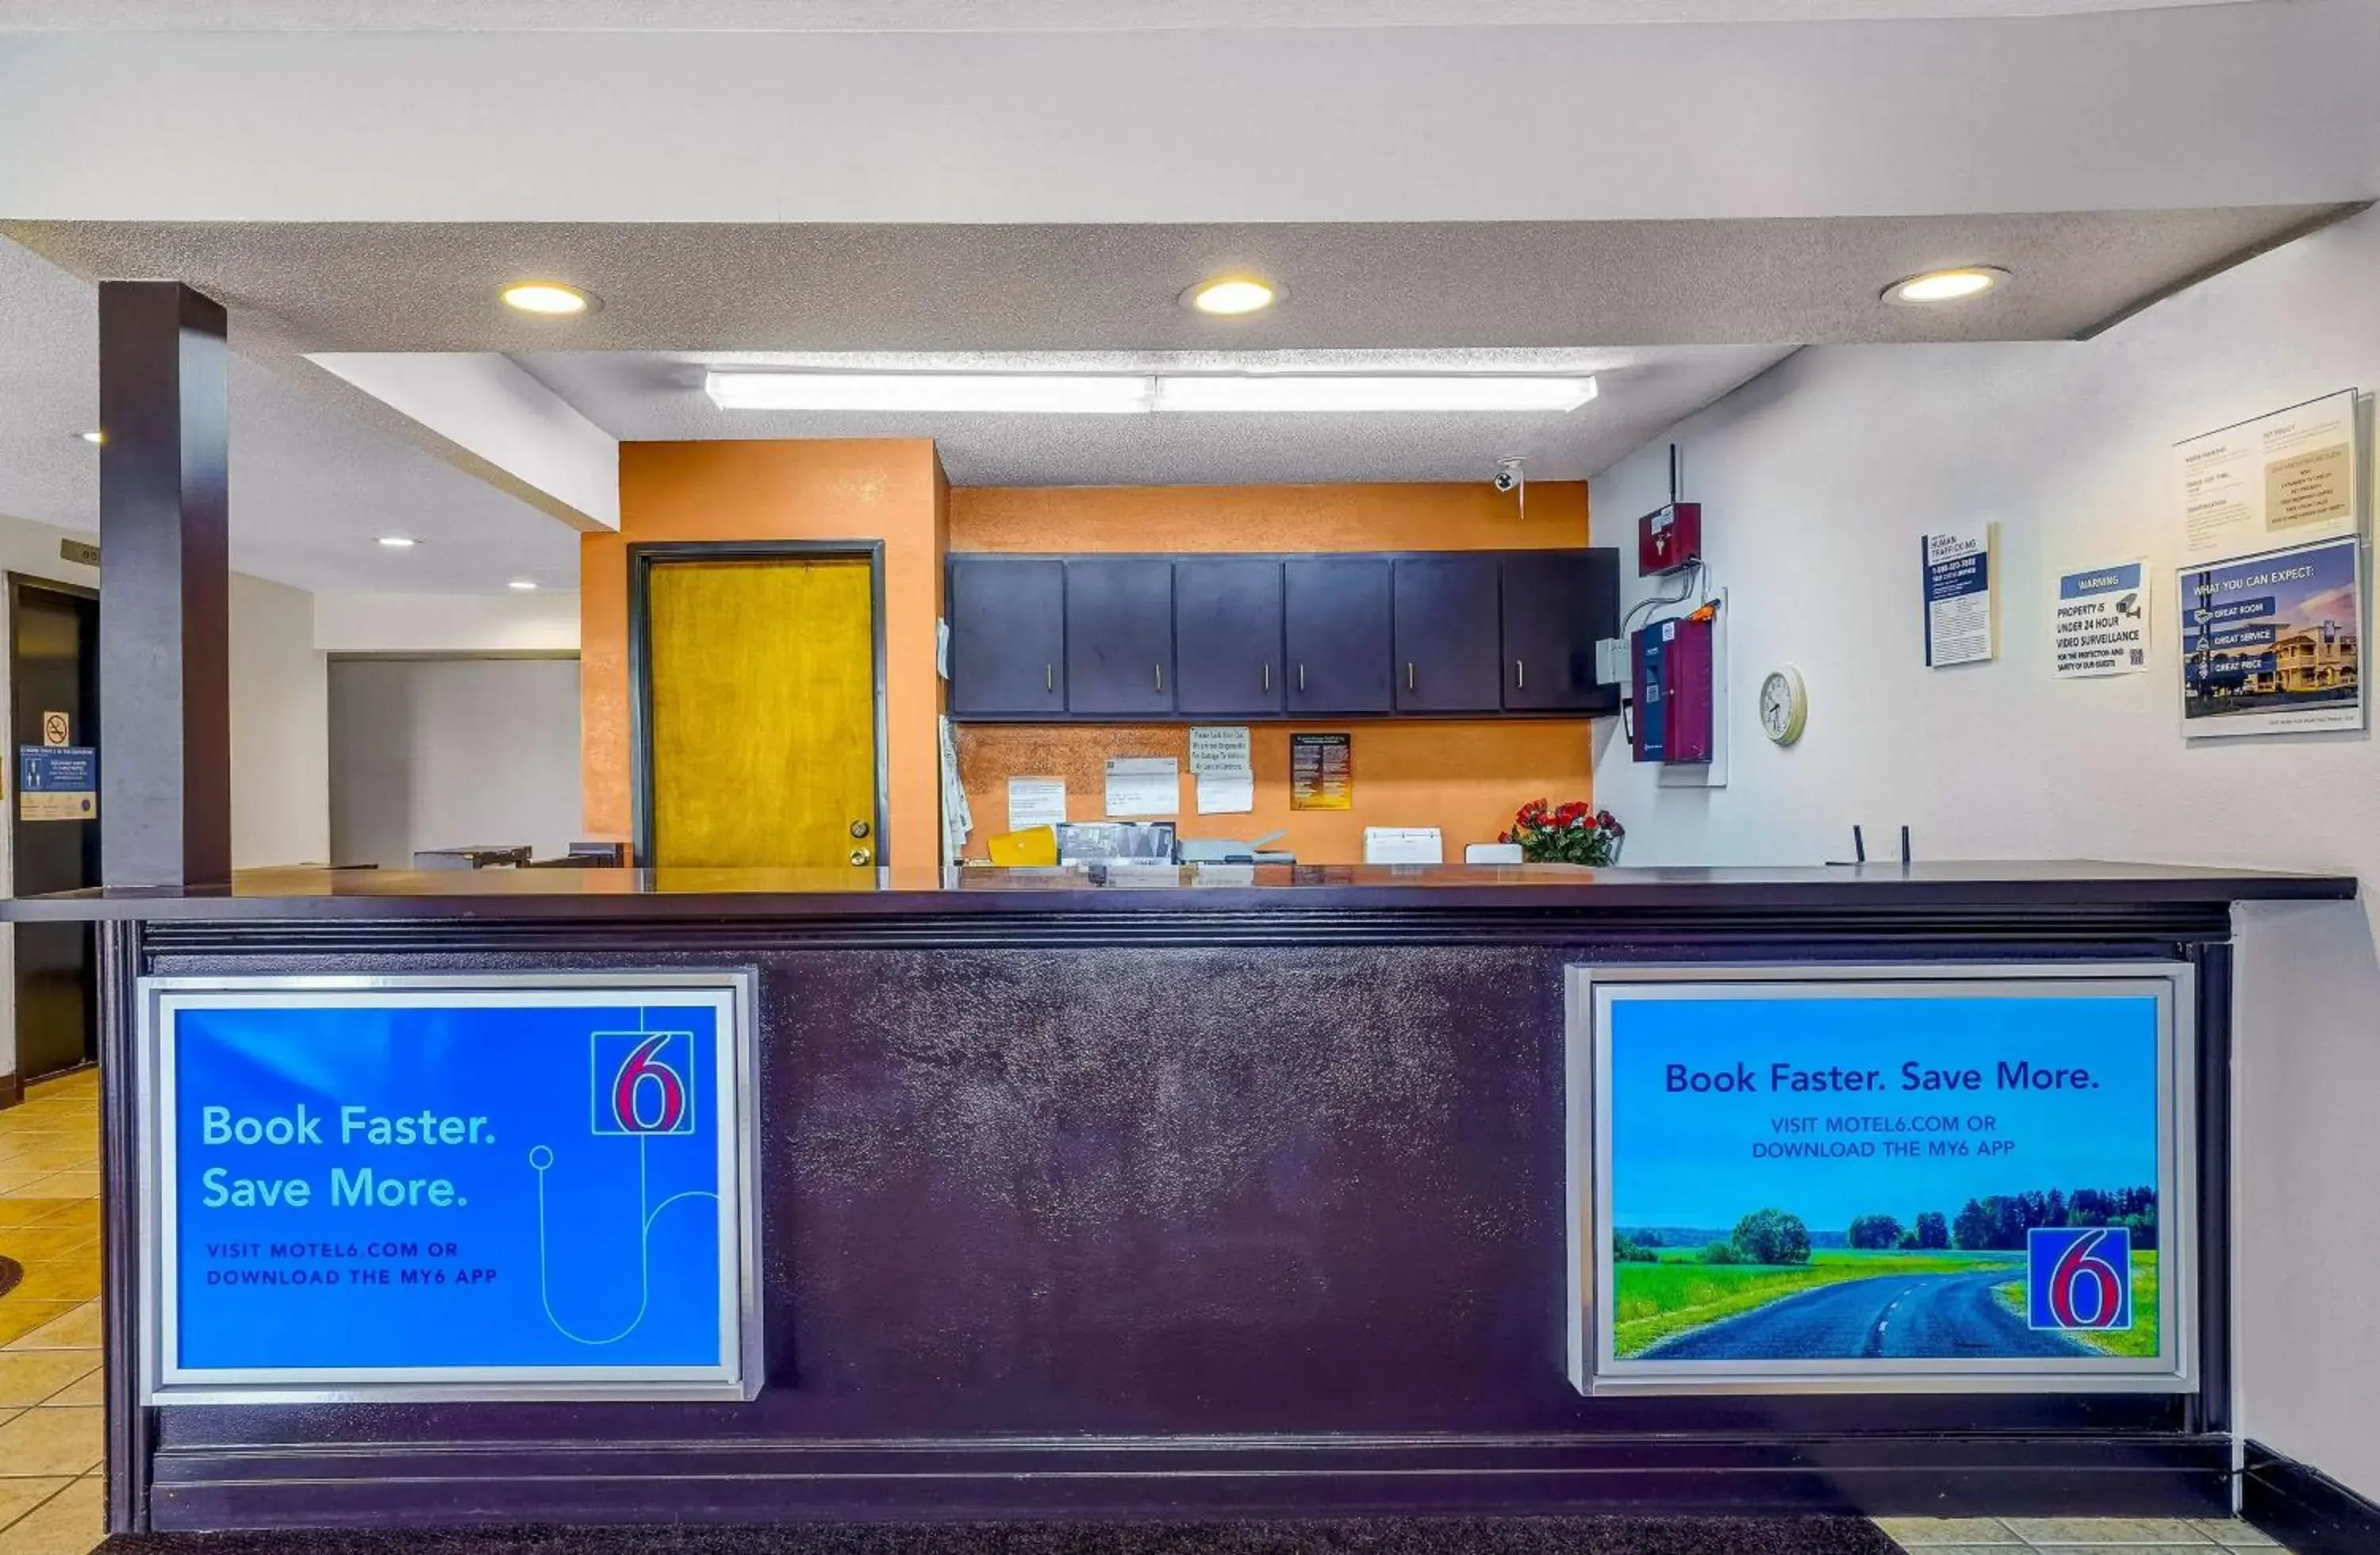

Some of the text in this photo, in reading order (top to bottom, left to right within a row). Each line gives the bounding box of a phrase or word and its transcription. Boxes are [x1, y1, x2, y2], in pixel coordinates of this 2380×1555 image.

[2079, 575, 2119, 590] WARNING
[2193, 566, 2315, 596] WHAT YOU CAN EXPECT:
[2057, 603, 2106, 618] PROPERTY IS
[2214, 602, 2263, 619] GREAT ROOM
[2057, 616, 2119, 633] UNDER 24 HOUR
[2056, 630, 2140, 648] VIDEO SURVEILLANCE
[2214, 629, 2271, 645] GREAT SERVICE
[2214, 659, 2263, 673] GREAT PRICE
[612, 1031, 685, 1135] 6
[1666, 1061, 2099, 1092] Book Faster. Save More.
[202, 1104, 496, 1146] Book Faster.
[1772, 1116, 1996, 1133] VISIT MOTEL6.COM OR
[1752, 1140, 2015, 1158] DOWNLOAD THE MY6 APP
[202, 1167, 467, 1208] Save More.
[207, 1242, 458, 1257] VISIT MOTEL6.COM OR
[208, 1269, 497, 1284] DOWNLOAD THE MY6 APP
[2049, 1228, 2121, 1330] 6
